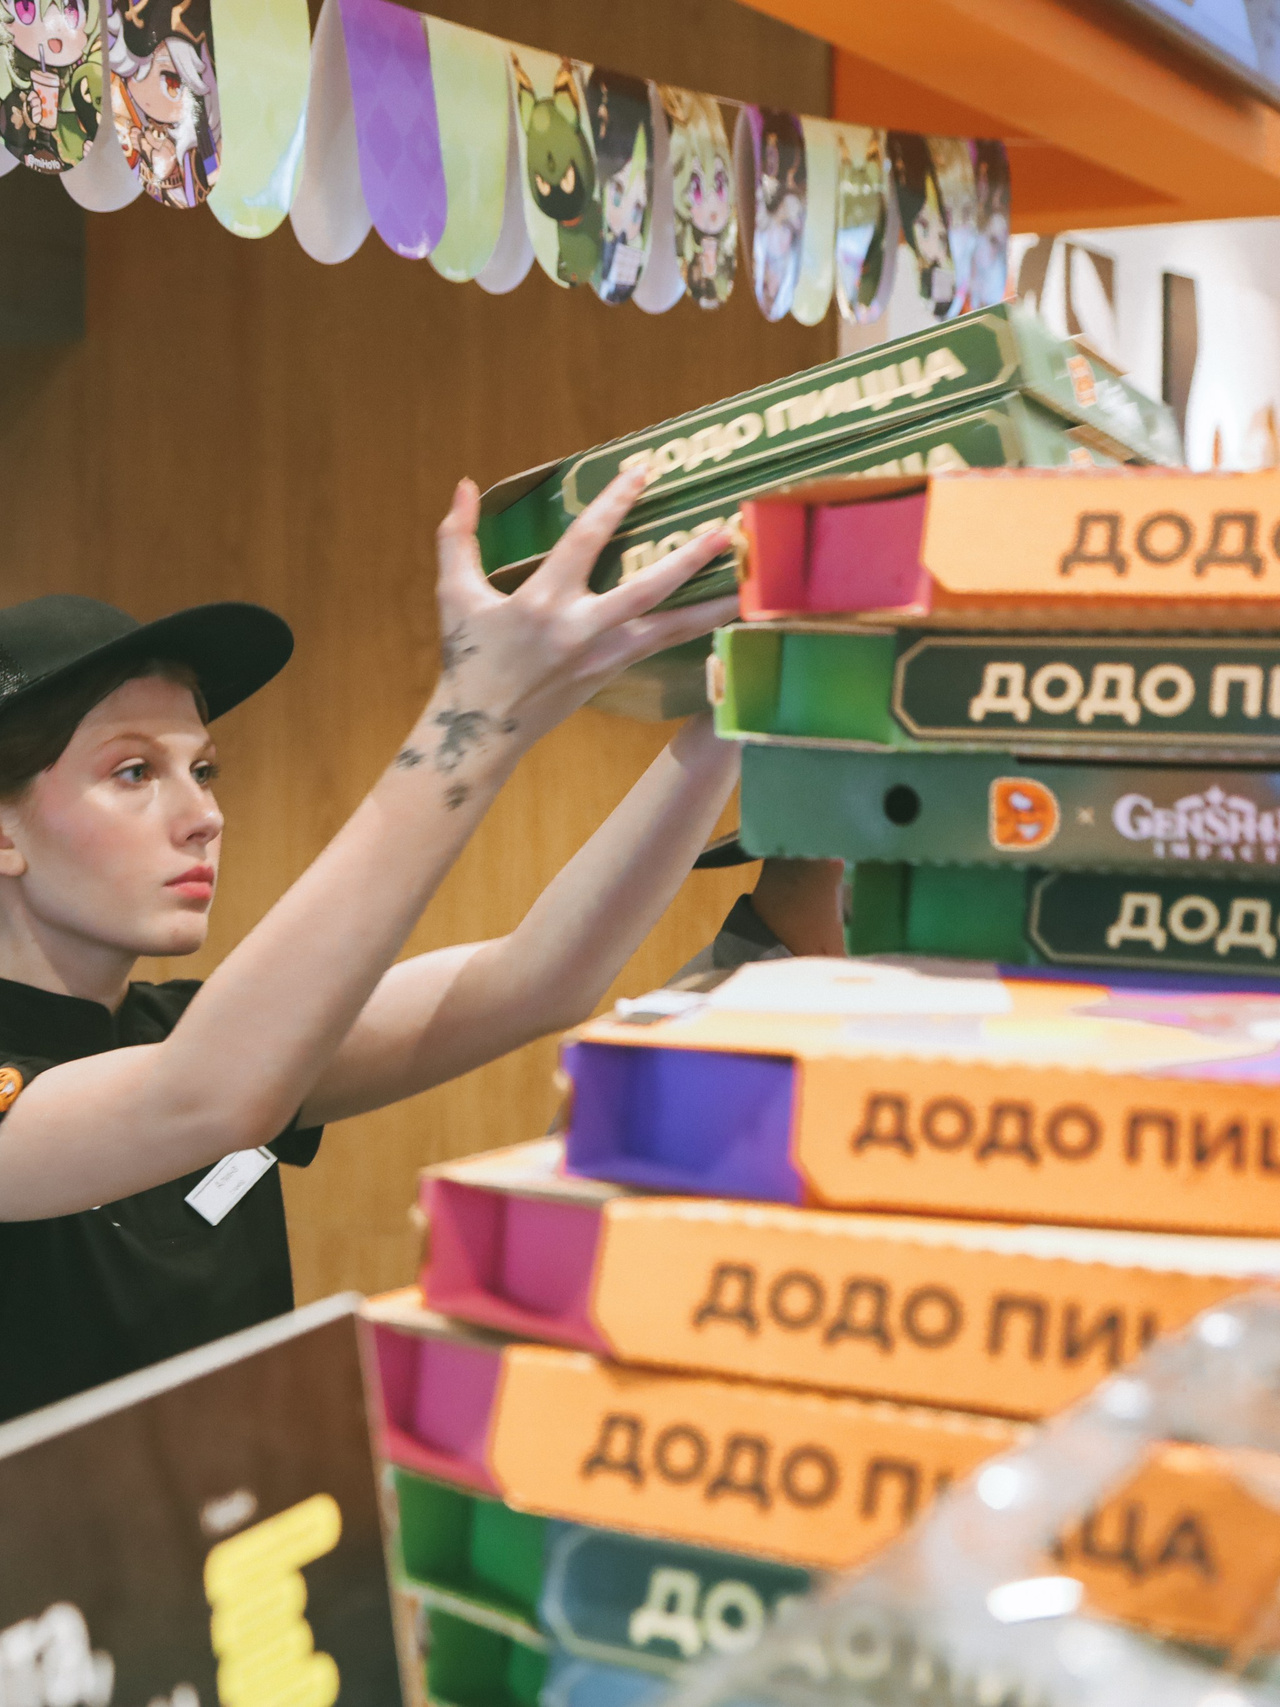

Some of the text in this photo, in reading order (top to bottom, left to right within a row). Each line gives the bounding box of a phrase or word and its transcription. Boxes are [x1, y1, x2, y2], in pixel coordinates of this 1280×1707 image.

[764, 347, 967, 438] ПИЦЦА
[1059, 510, 1280, 578] ДОД
[969, 661, 1196, 726] ДОДО
[1106, 892, 1280, 959] ДОД
[851, 1092, 1103, 1173] ДОДО
[692, 1261, 965, 1357] ДОДО
[578, 1410, 839, 1514] ДОДО
